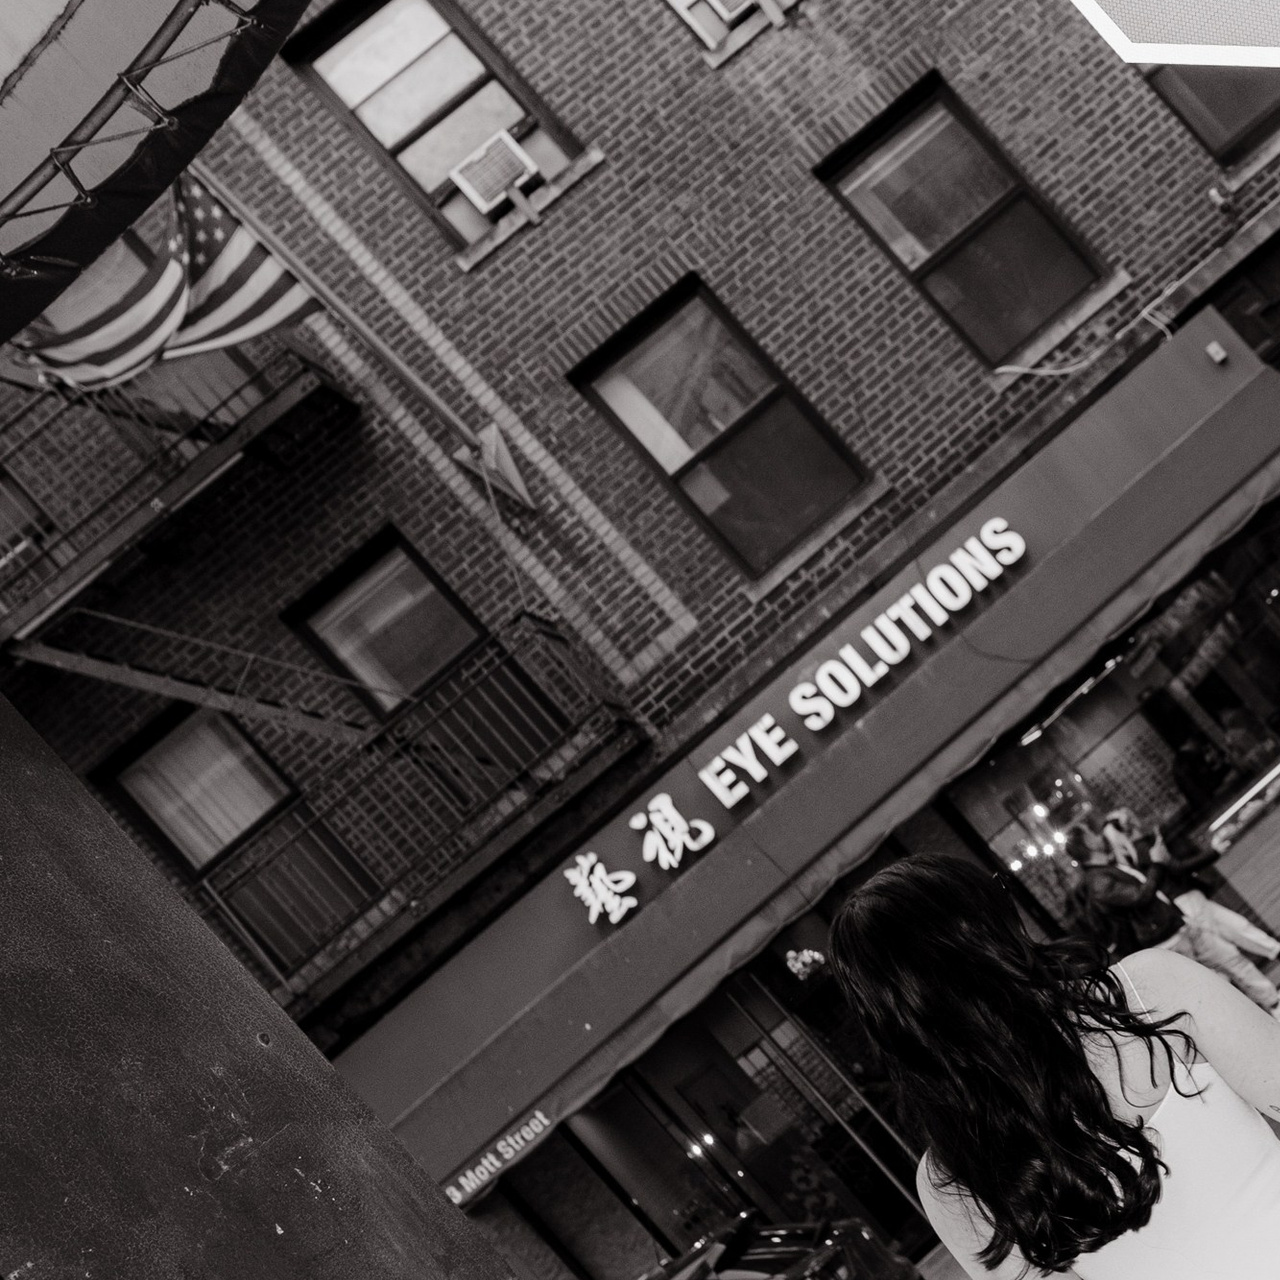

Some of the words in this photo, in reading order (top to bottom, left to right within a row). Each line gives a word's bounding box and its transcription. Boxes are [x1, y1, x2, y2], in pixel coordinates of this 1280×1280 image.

[698, 712, 799, 809] EYE
[788, 516, 1026, 731] SOLUTIONS
[458, 1152, 503, 1193] Mott
[496, 1110, 551, 1160] Street
